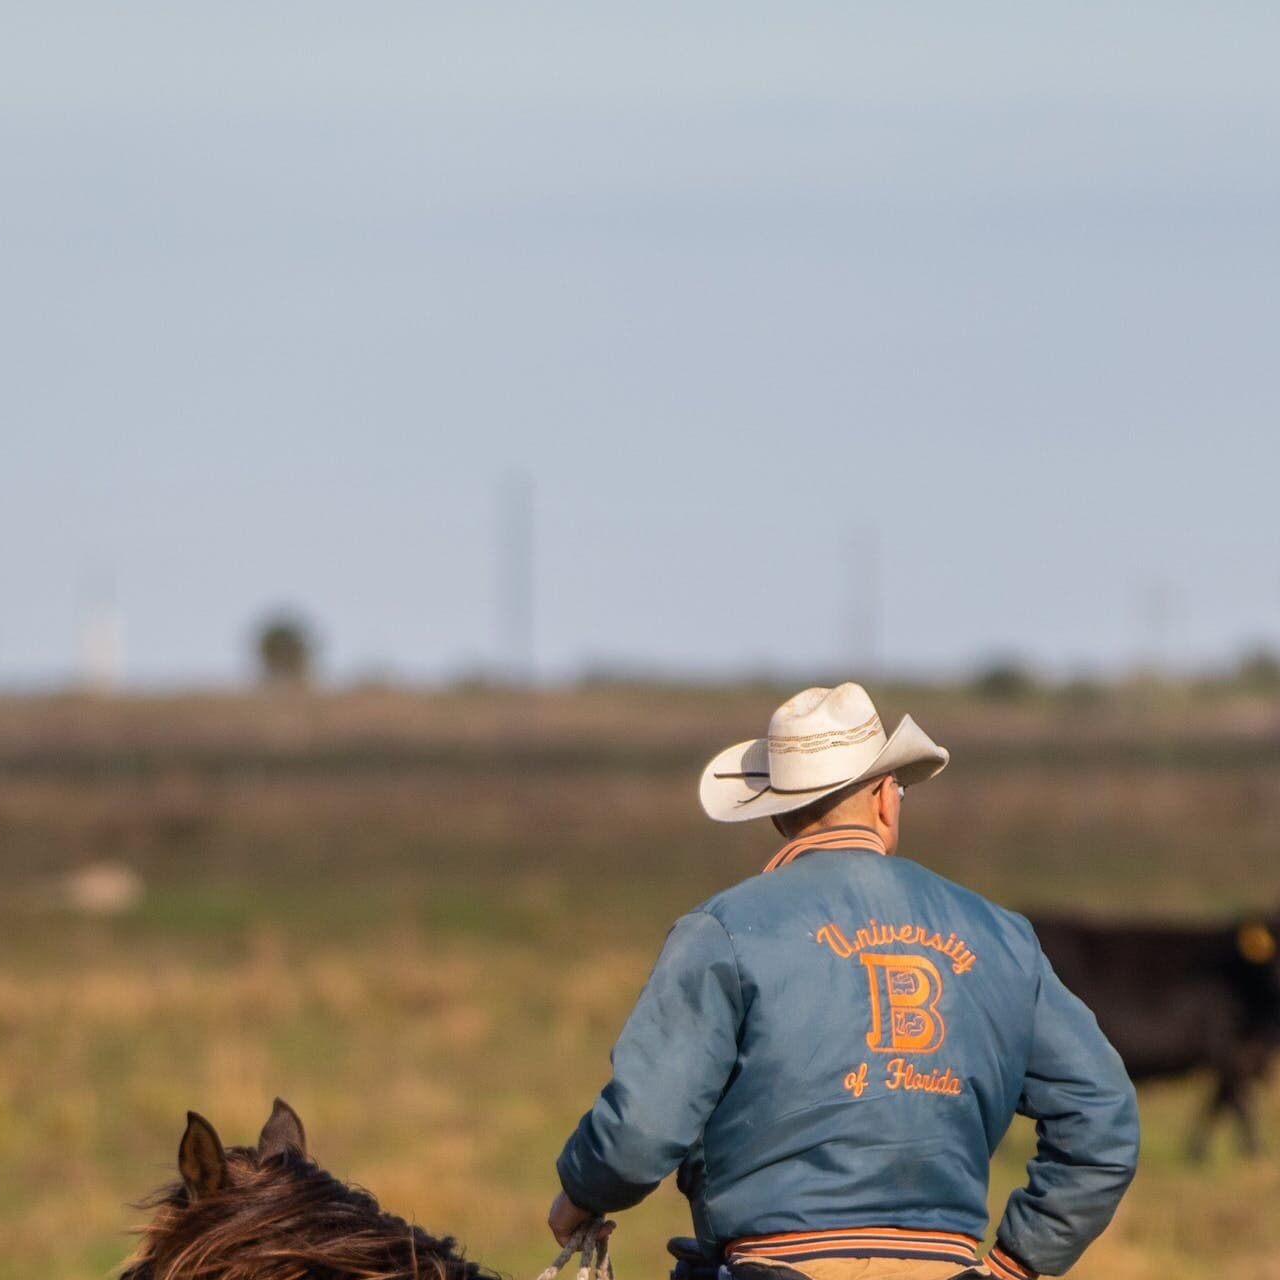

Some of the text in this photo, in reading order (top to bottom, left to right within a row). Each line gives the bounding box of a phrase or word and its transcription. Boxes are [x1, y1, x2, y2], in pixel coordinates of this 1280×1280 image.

[816, 919, 976, 974] University
[860, 953, 945, 1054] B
[844, 1058, 961, 1097] of Florida
